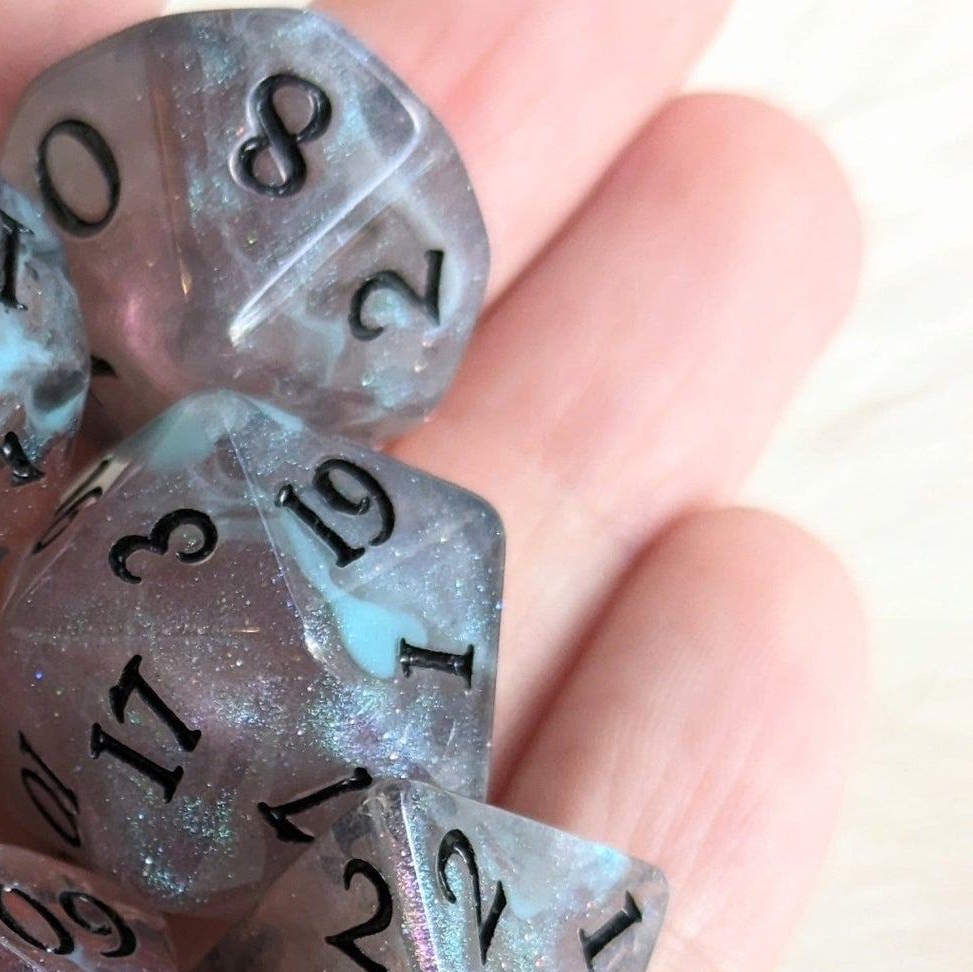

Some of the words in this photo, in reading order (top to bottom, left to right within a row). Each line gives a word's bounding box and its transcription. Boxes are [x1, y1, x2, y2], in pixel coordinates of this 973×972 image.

[37, 119, 121, 238] 0
[230, 74, 332, 197] 8
[350, 250, 444, 341] 2
[108, 508, 218, 584] 3
[275, 458, 395, 568] 19
[400, 638, 475, 689] 1
[90, 655, 201, 803] 17
[437, 829, 507, 966] 2
